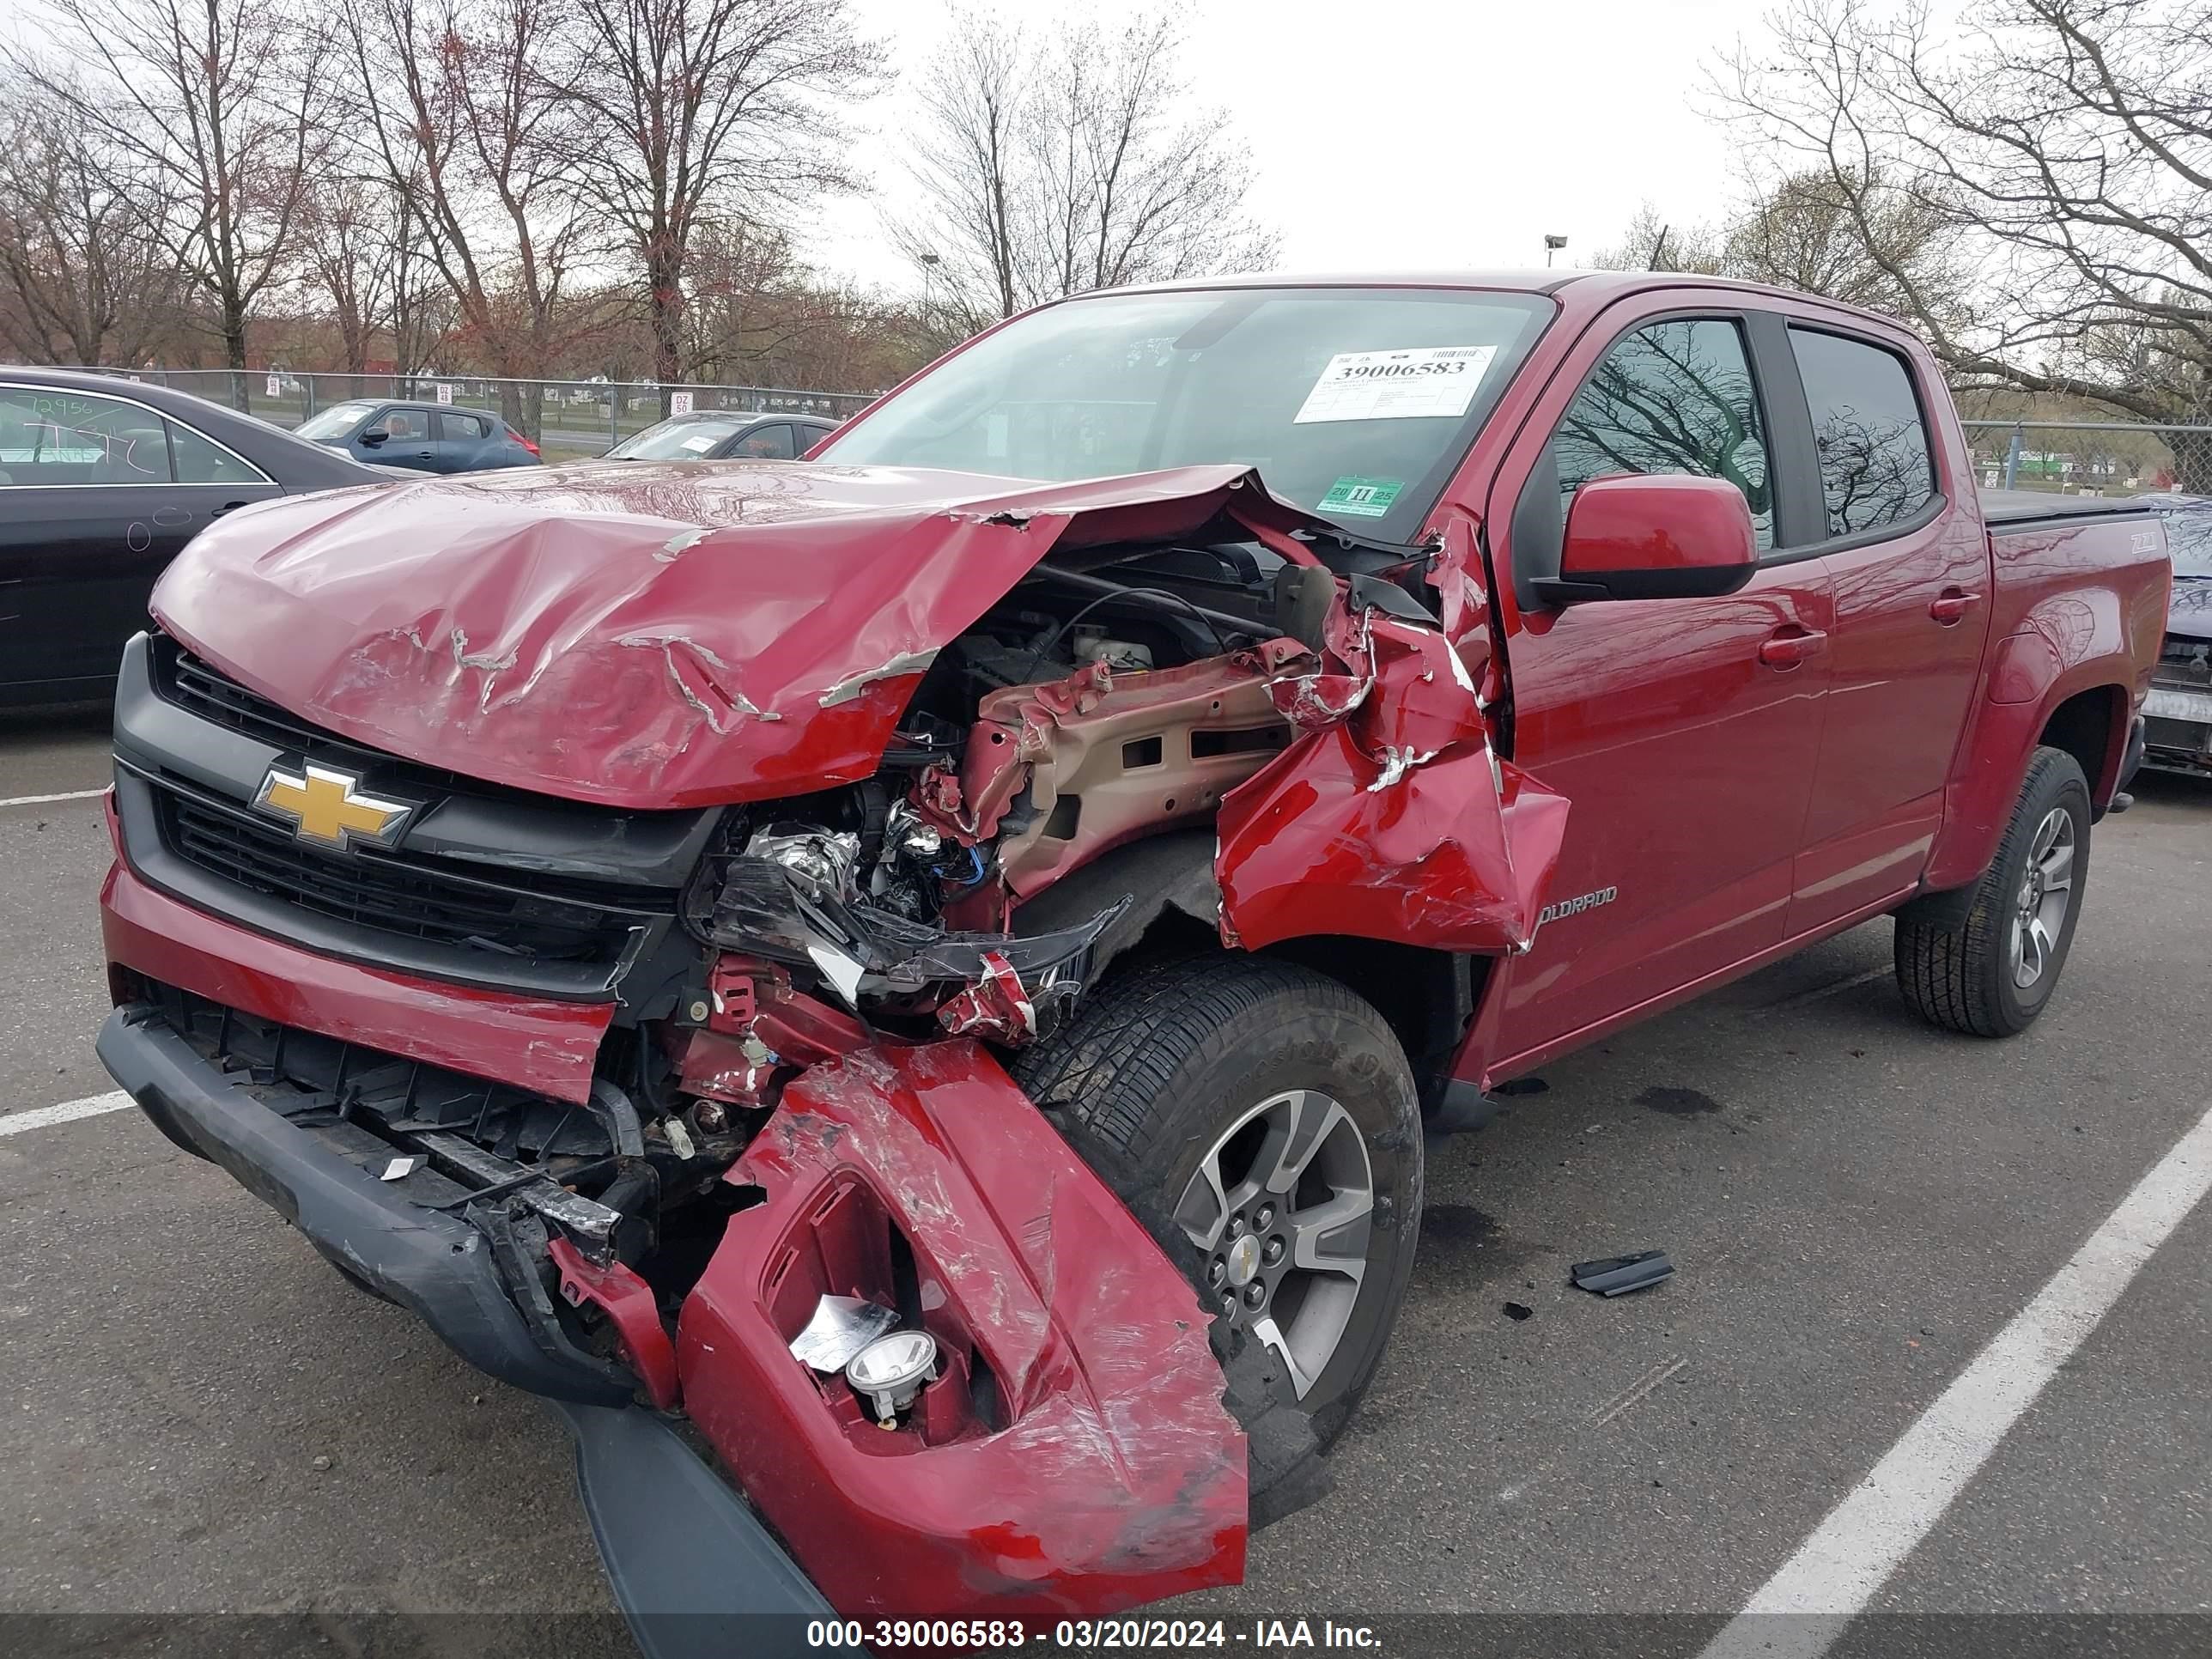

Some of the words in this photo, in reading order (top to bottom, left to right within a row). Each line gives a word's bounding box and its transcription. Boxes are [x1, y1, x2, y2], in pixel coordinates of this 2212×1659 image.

[1335, 362, 1466, 380] 39006583
[15, 395, 93, 416] 72956
[677, 396, 688, 404] DZ
[677, 404, 687, 413] 50
[1332, 487, 1348, 496] 20
[1351, 488, 1370, 501] 11
[1375, 491, 1395, 500] 25
[1540, 885, 1618, 924] OLORADO
